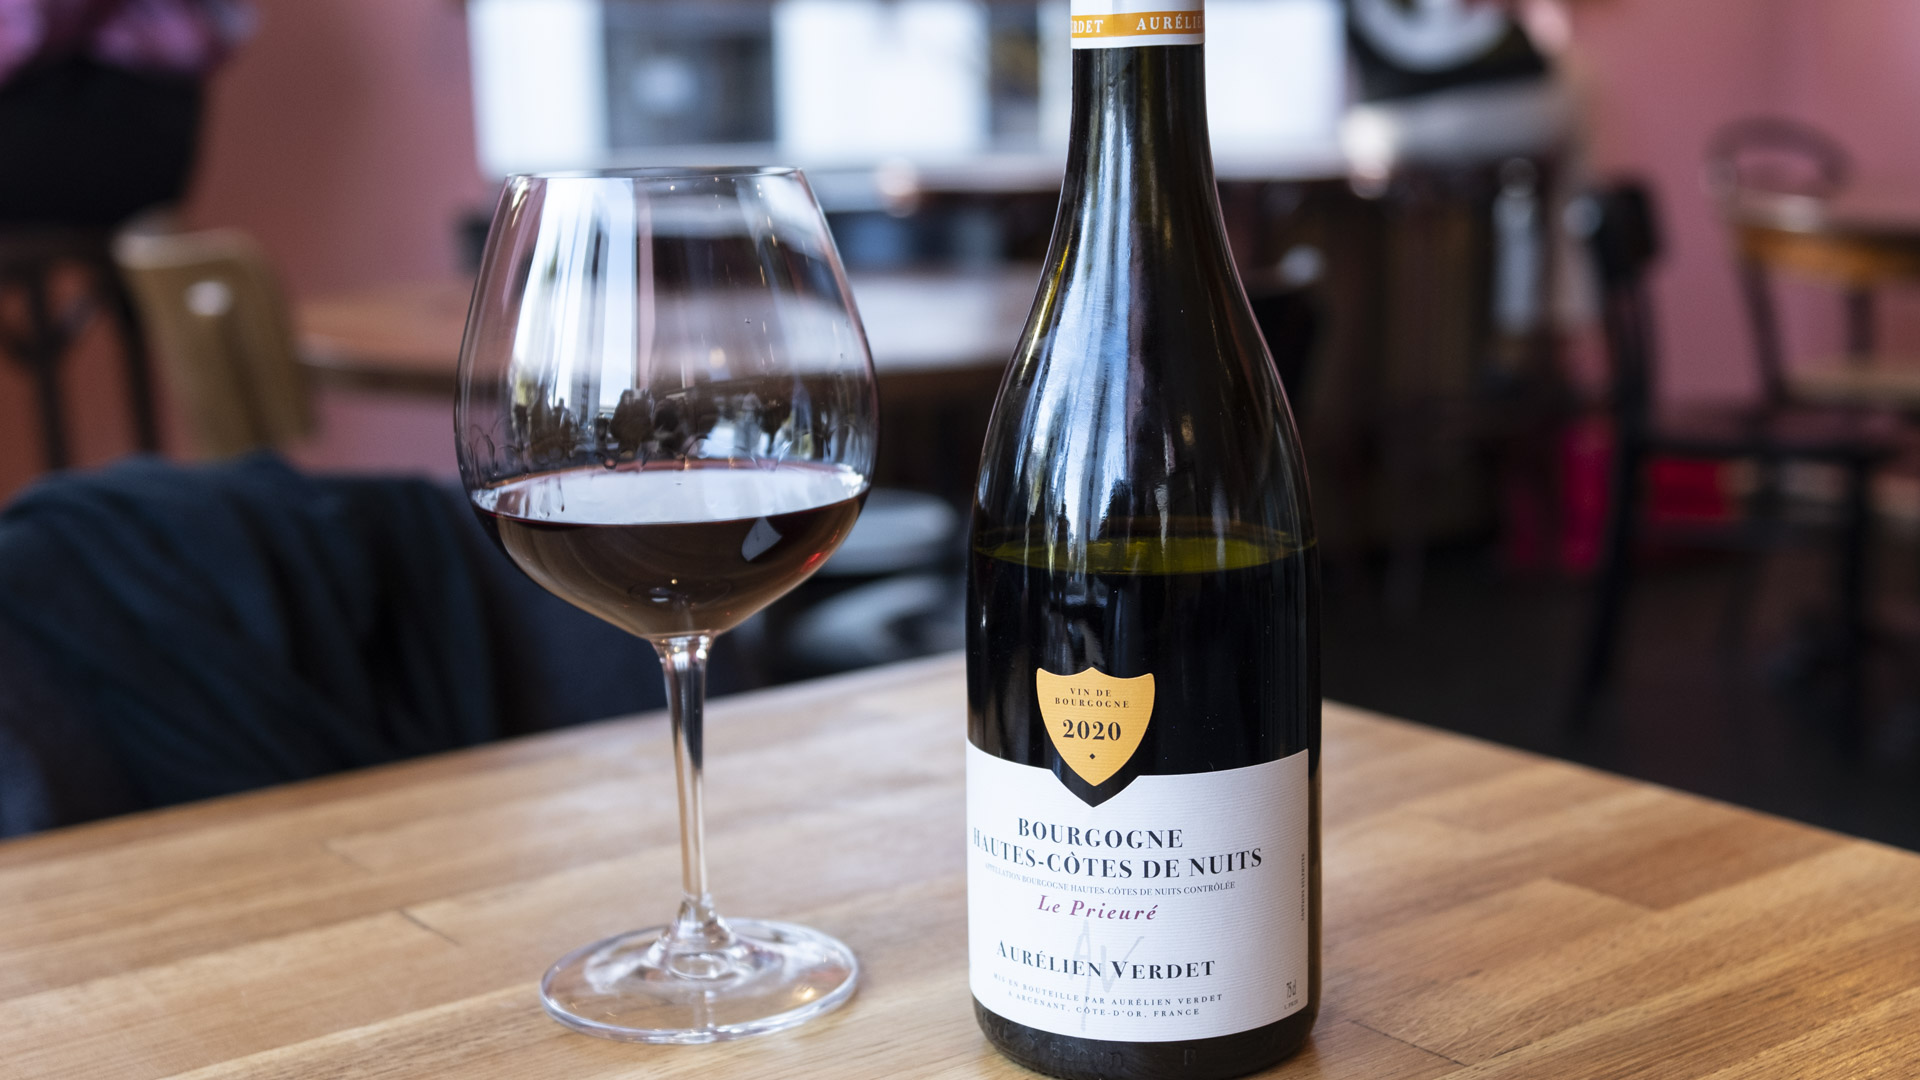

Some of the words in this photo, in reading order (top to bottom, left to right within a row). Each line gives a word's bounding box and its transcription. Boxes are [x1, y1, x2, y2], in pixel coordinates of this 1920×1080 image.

[1055, 697, 1130, 708] BOURGOGNE
[1070, 687, 1090, 696] VIN
[1096, 689, 1112, 697] DE
[1062, 719, 1121, 741] 2020
[1018, 817, 1183, 849] BOURGOGNE
[1142, 859, 1180, 879] DE
[1188, 847, 1262, 877] NUITS
[1021, 874, 1070, 892] BOURGOGNE
[1140, 887, 1153, 896] DE
[1154, 886, 1182, 896] NUITS
[1183, 880, 1236, 895] CONTRÔLÉE
[1037, 894, 1061, 914] Le
[1069, 899, 1159, 921] Prieuré
[1022, 983, 1080, 1002] BOUTEILLE
[1084, 995, 1105, 1005] PAR
[1111, 997, 1172, 1006] AURÉLIEN
[1177, 993, 1223, 1005] VERDET
[1153, 1008, 1200, 1018] FRANCE
